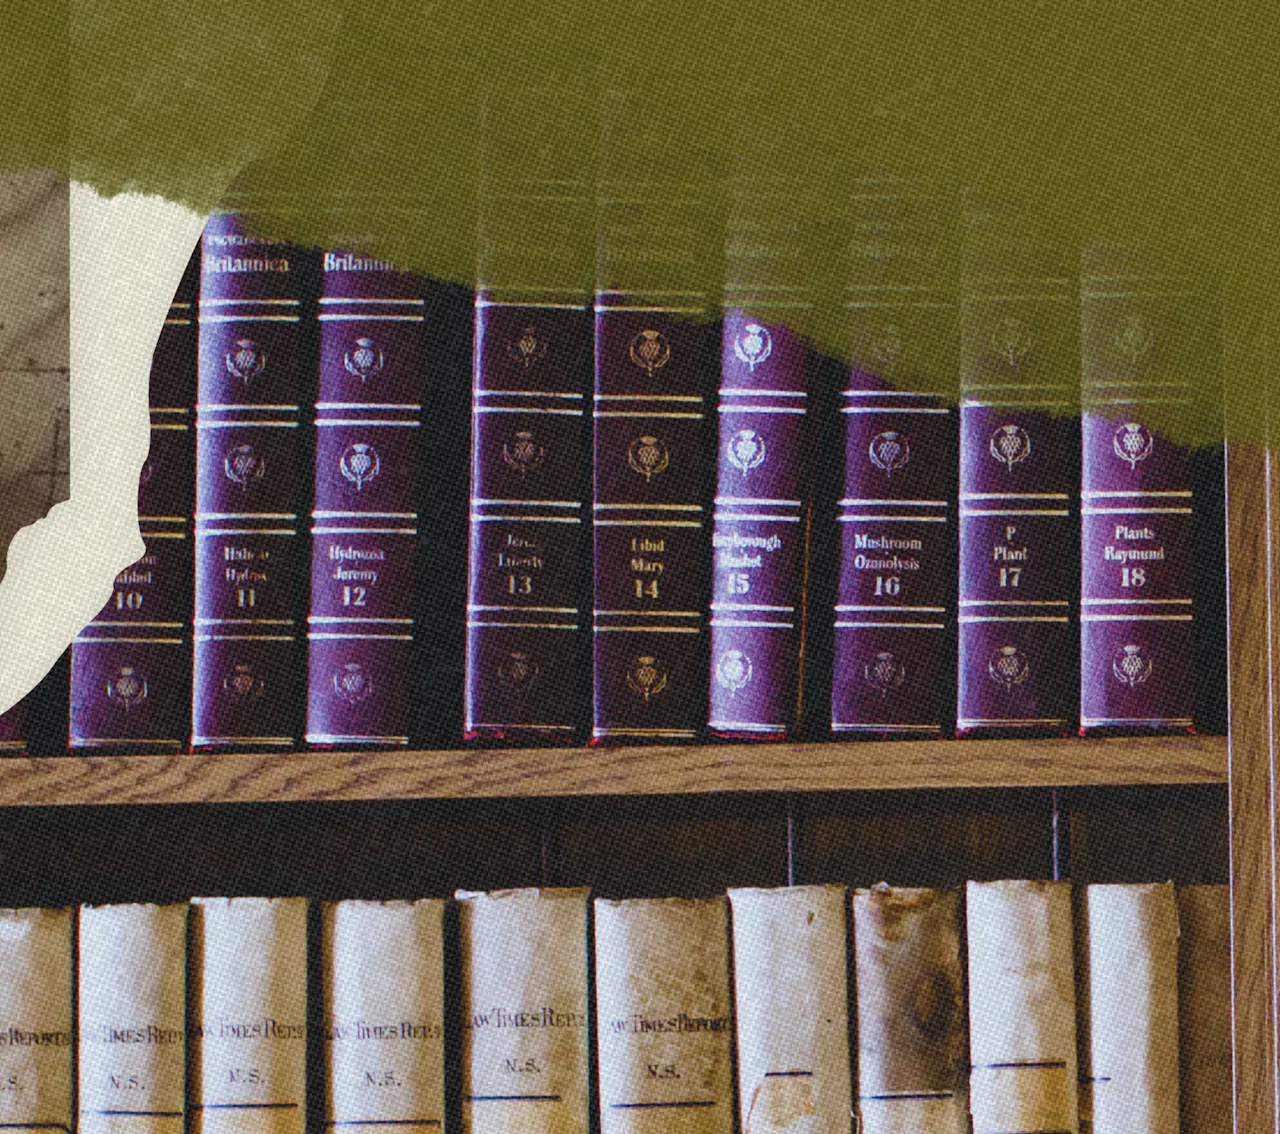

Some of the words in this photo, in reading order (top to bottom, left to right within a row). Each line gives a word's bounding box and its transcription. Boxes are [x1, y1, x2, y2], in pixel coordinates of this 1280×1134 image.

[1006, 527, 1016, 540] P
[1115, 526, 1154, 540] Plants
[631, 538, 665, 553] Libid
[854, 534, 922, 550] Mushroom
[993, 547, 1028, 561] Plant
[631, 558, 665, 576] Mary
[508, 575, 532, 594] 13
[727, 574, 750, 594] 15
[999, 568, 1022, 587] 17
[1120, 568, 1146, 587] 18
[635, 579, 659, 598] 14
[874, 577, 901, 596] 16
[117, 592, 143, 609] 10
[237, 589, 256, 606] 11
[343, 586, 367, 606] 12
[504, 1059, 541, 1073] N.S.
[646, 1064, 680, 1079] N.S.
[110, 1075, 145, 1090] N.S.
[366, 1072, 402, 1086] N.S.
